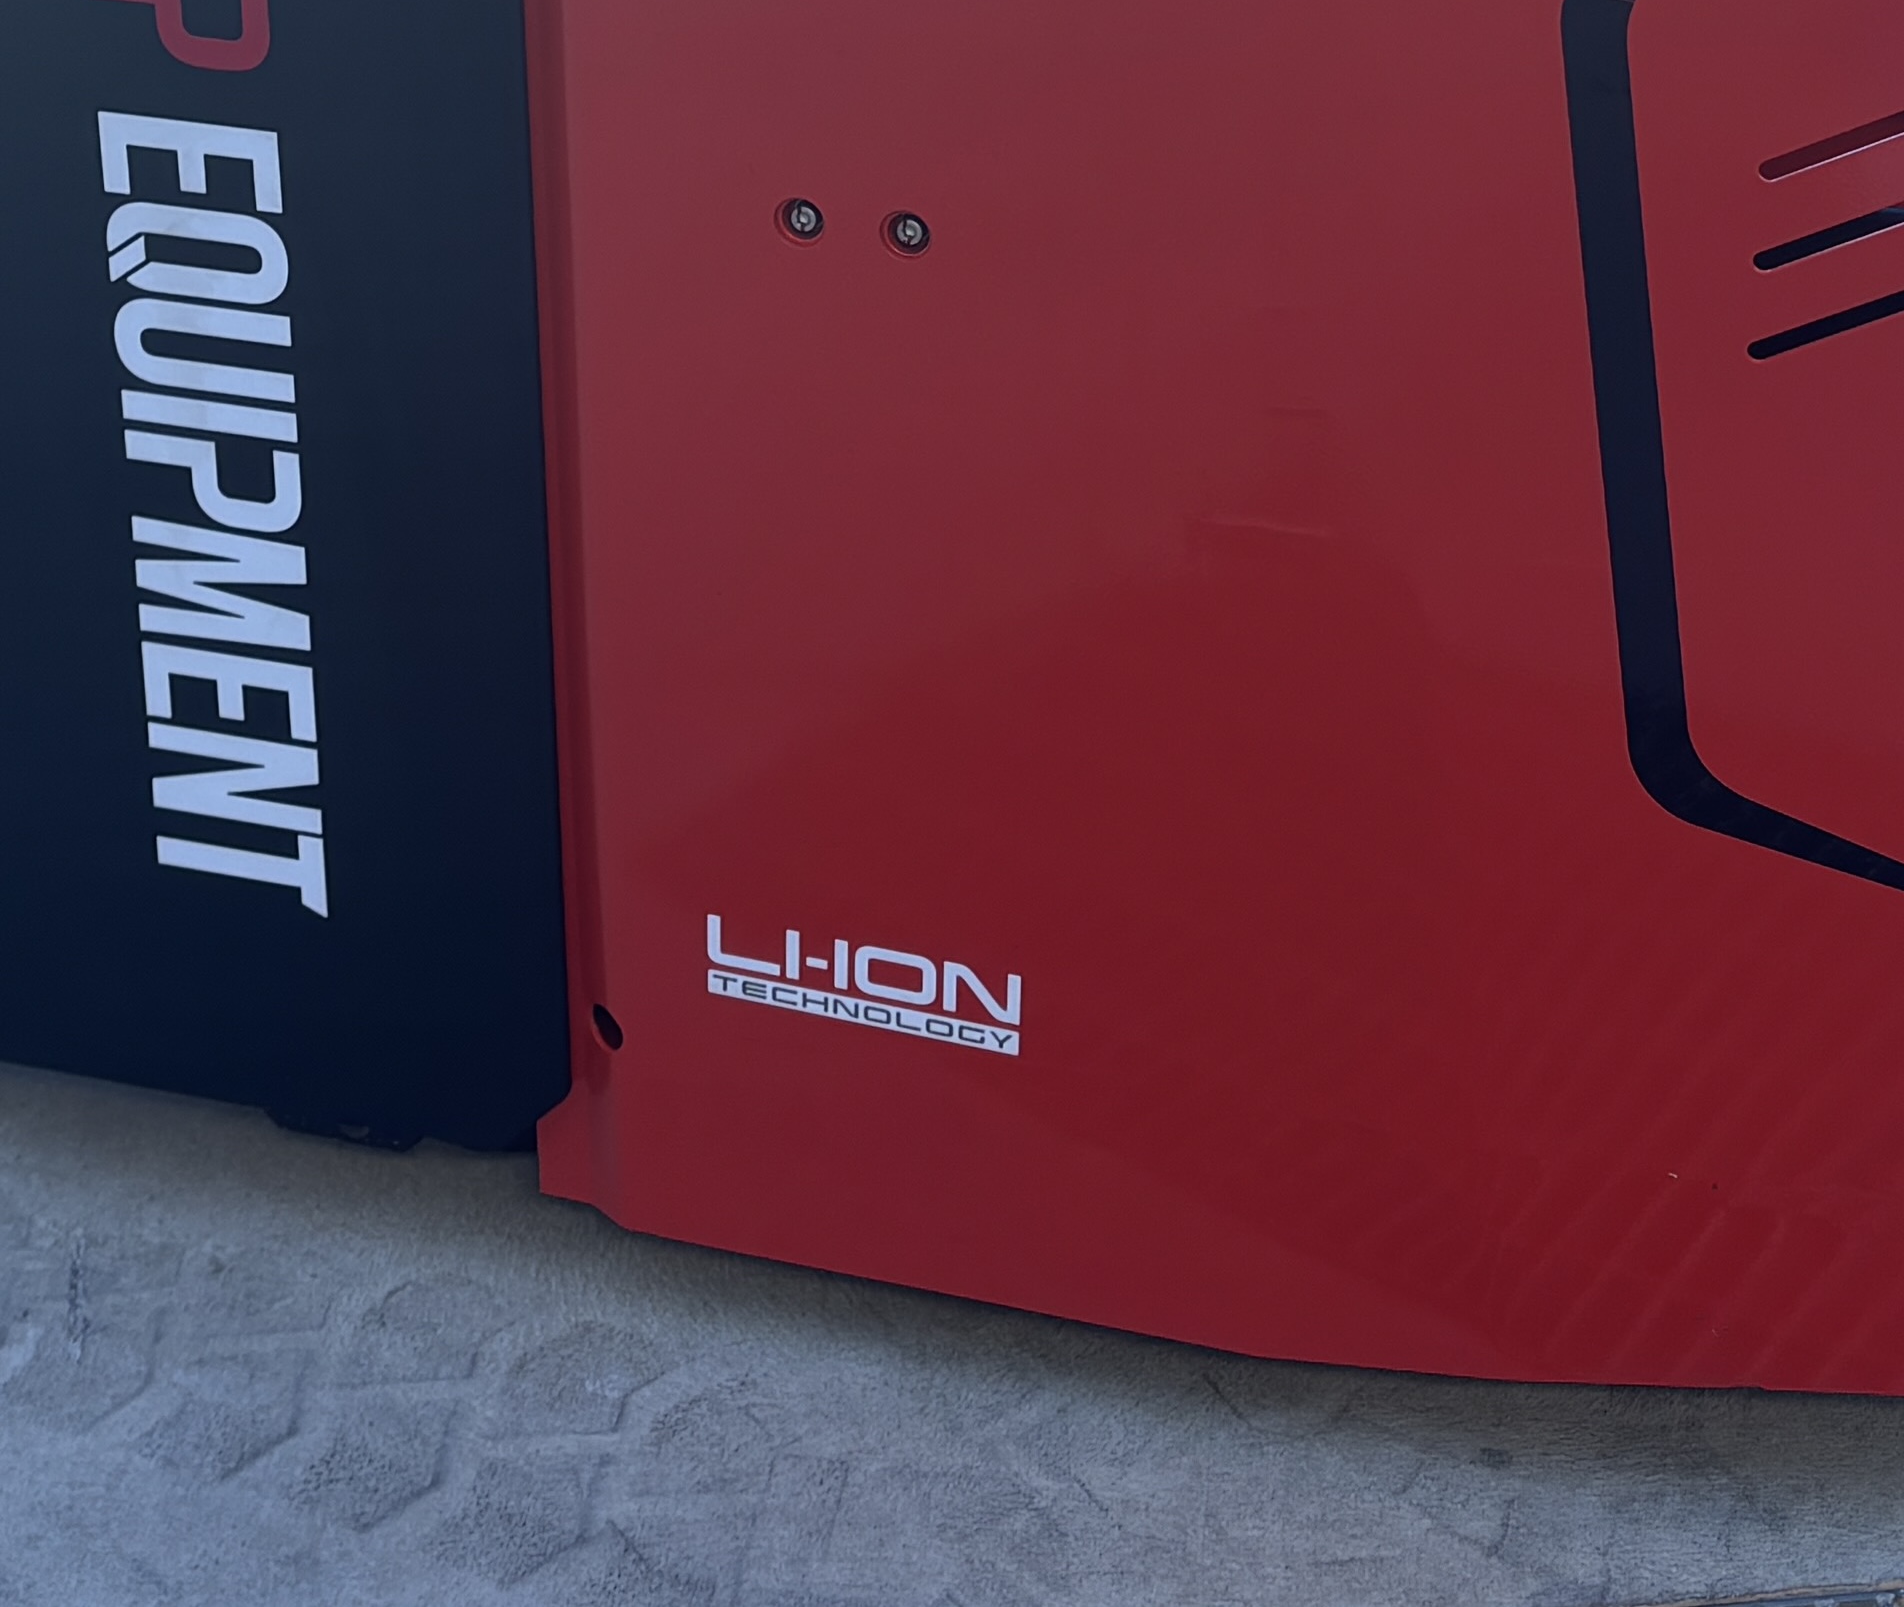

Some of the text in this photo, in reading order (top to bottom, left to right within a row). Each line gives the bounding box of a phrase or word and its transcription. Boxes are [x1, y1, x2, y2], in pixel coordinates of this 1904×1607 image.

[97, 111, 329, 919] EQUIPMENT
[707, 914, 1022, 1026] LI-ION
[712, 973, 1013, 1049] TECHNOLOGY
